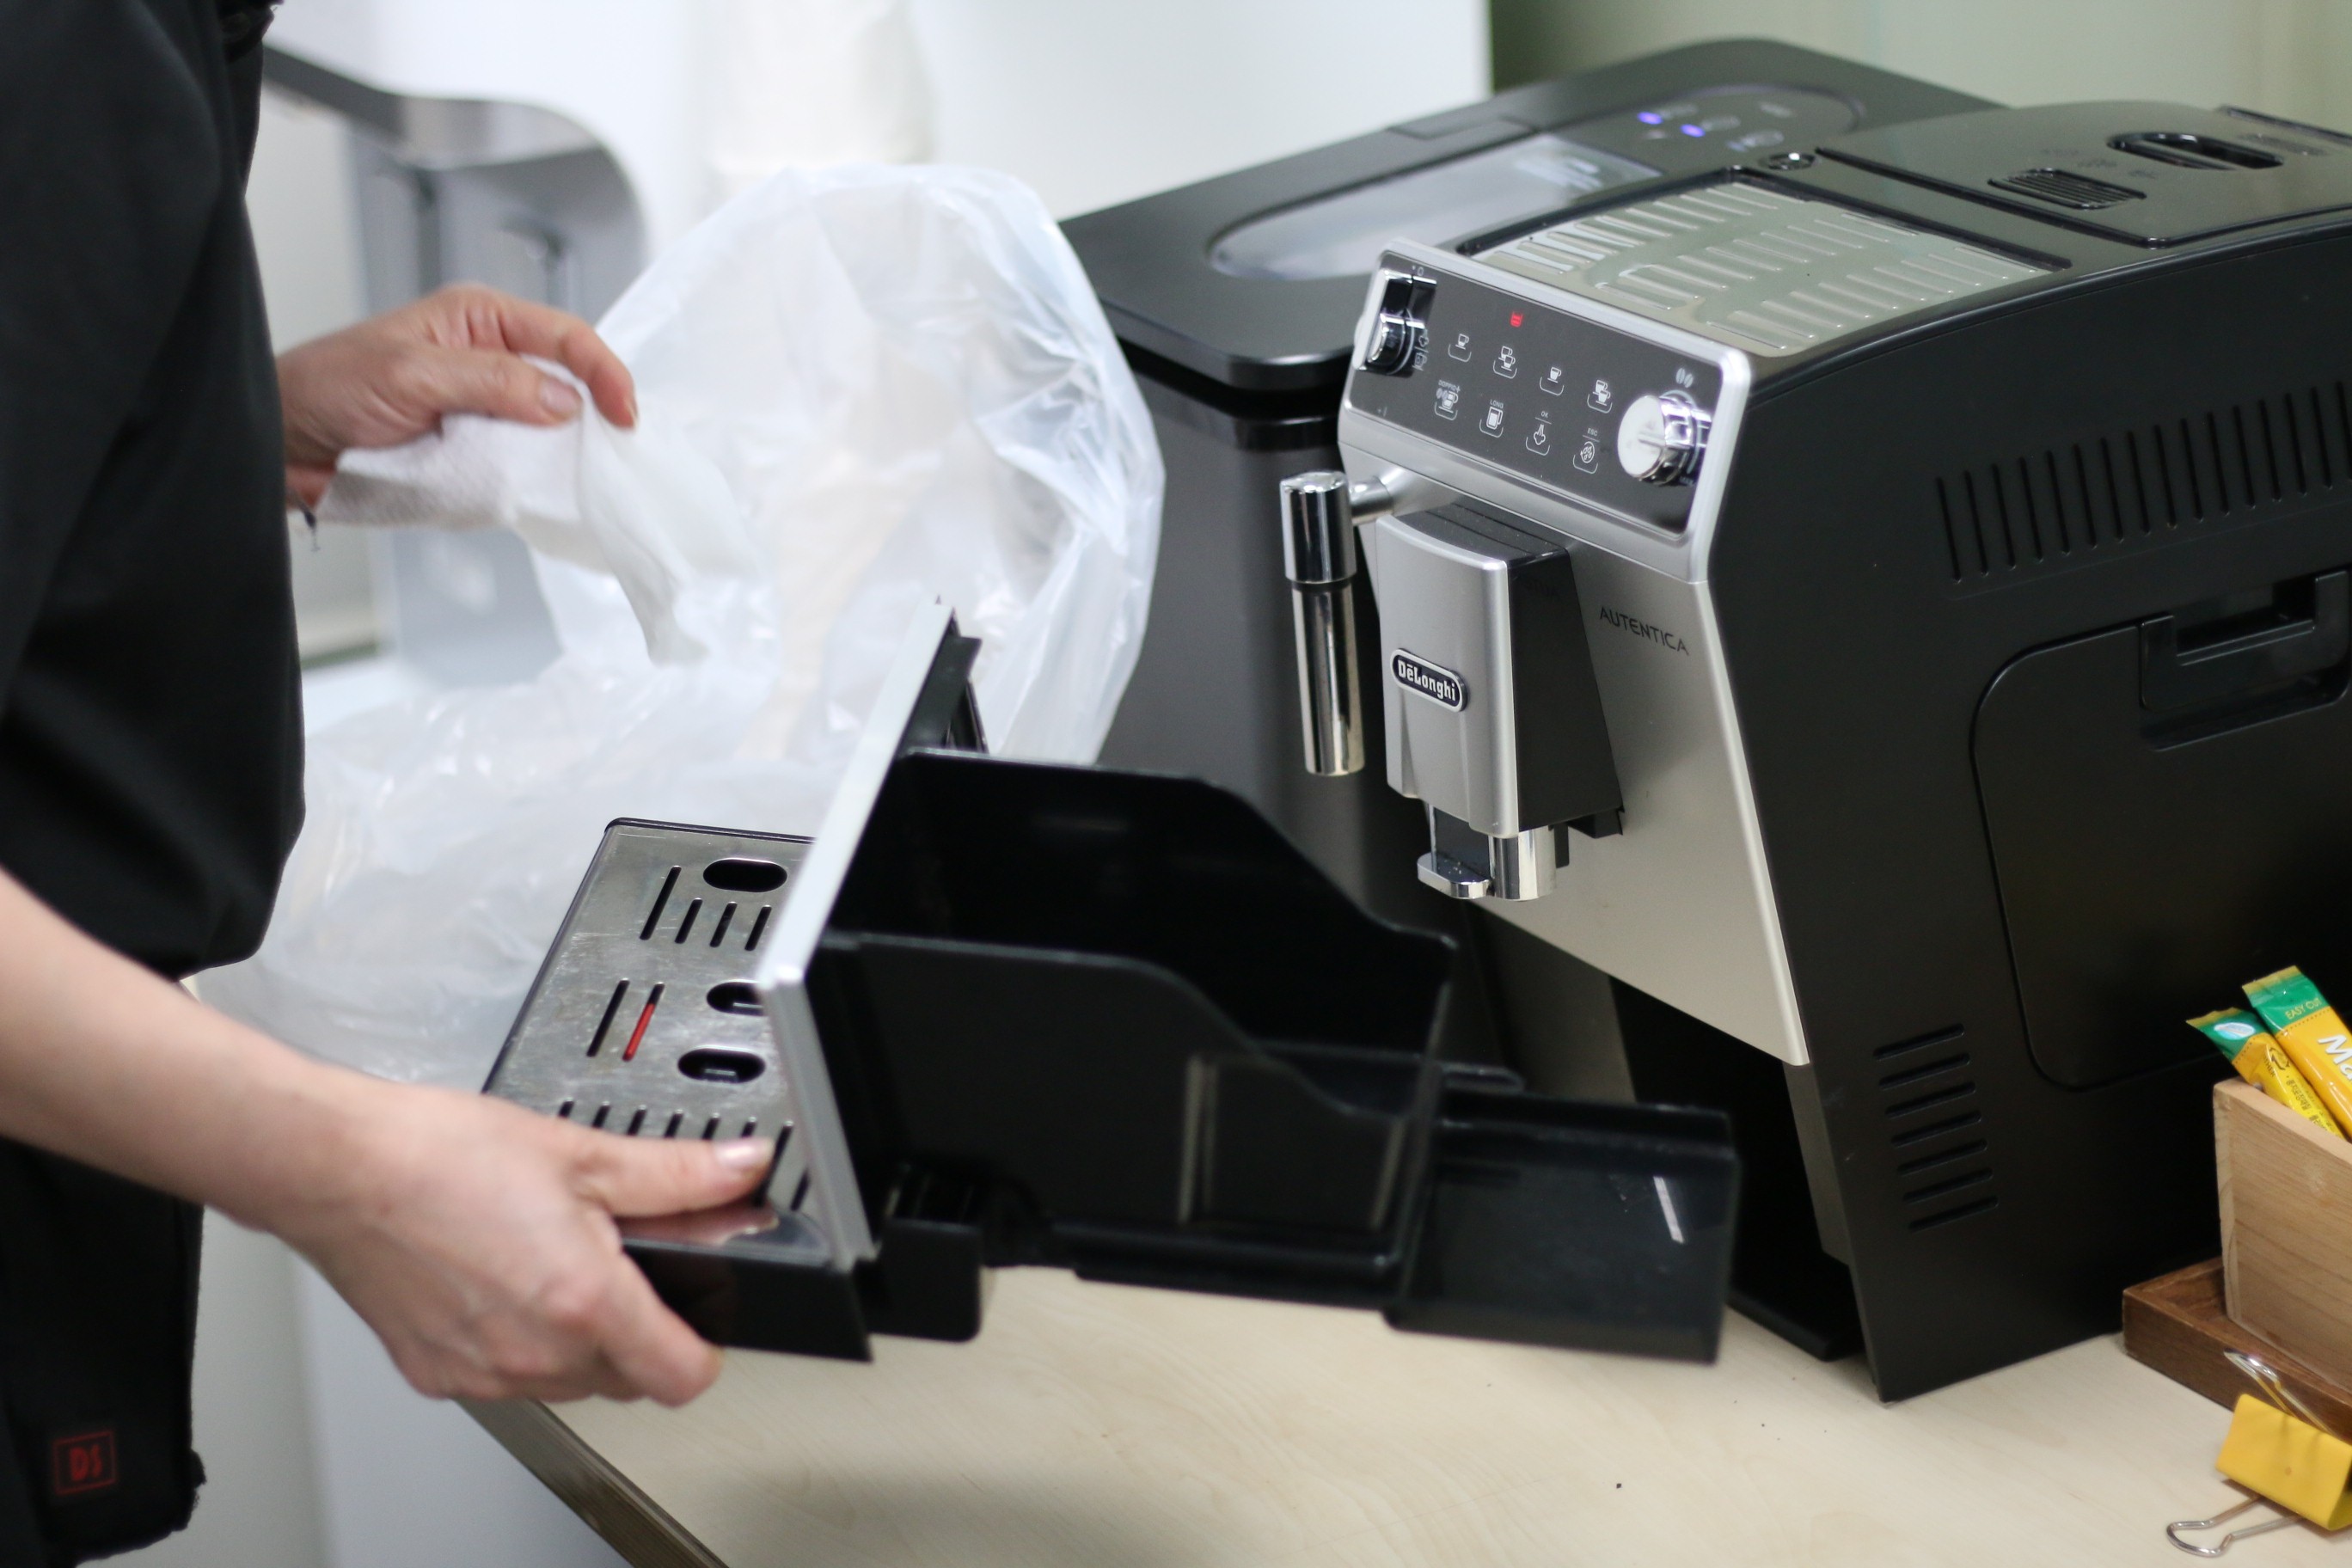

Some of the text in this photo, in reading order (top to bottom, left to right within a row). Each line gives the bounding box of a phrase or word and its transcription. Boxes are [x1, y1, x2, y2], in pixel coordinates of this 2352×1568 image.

[1490, 399, 1504, 409] LONG
[1540, 410, 1549, 419] OK
[1587, 427, 1598, 437] ESC
[1599, 605, 1689, 656] AUTENTICA
[2285, 997, 2323, 1020] EASY CUT
